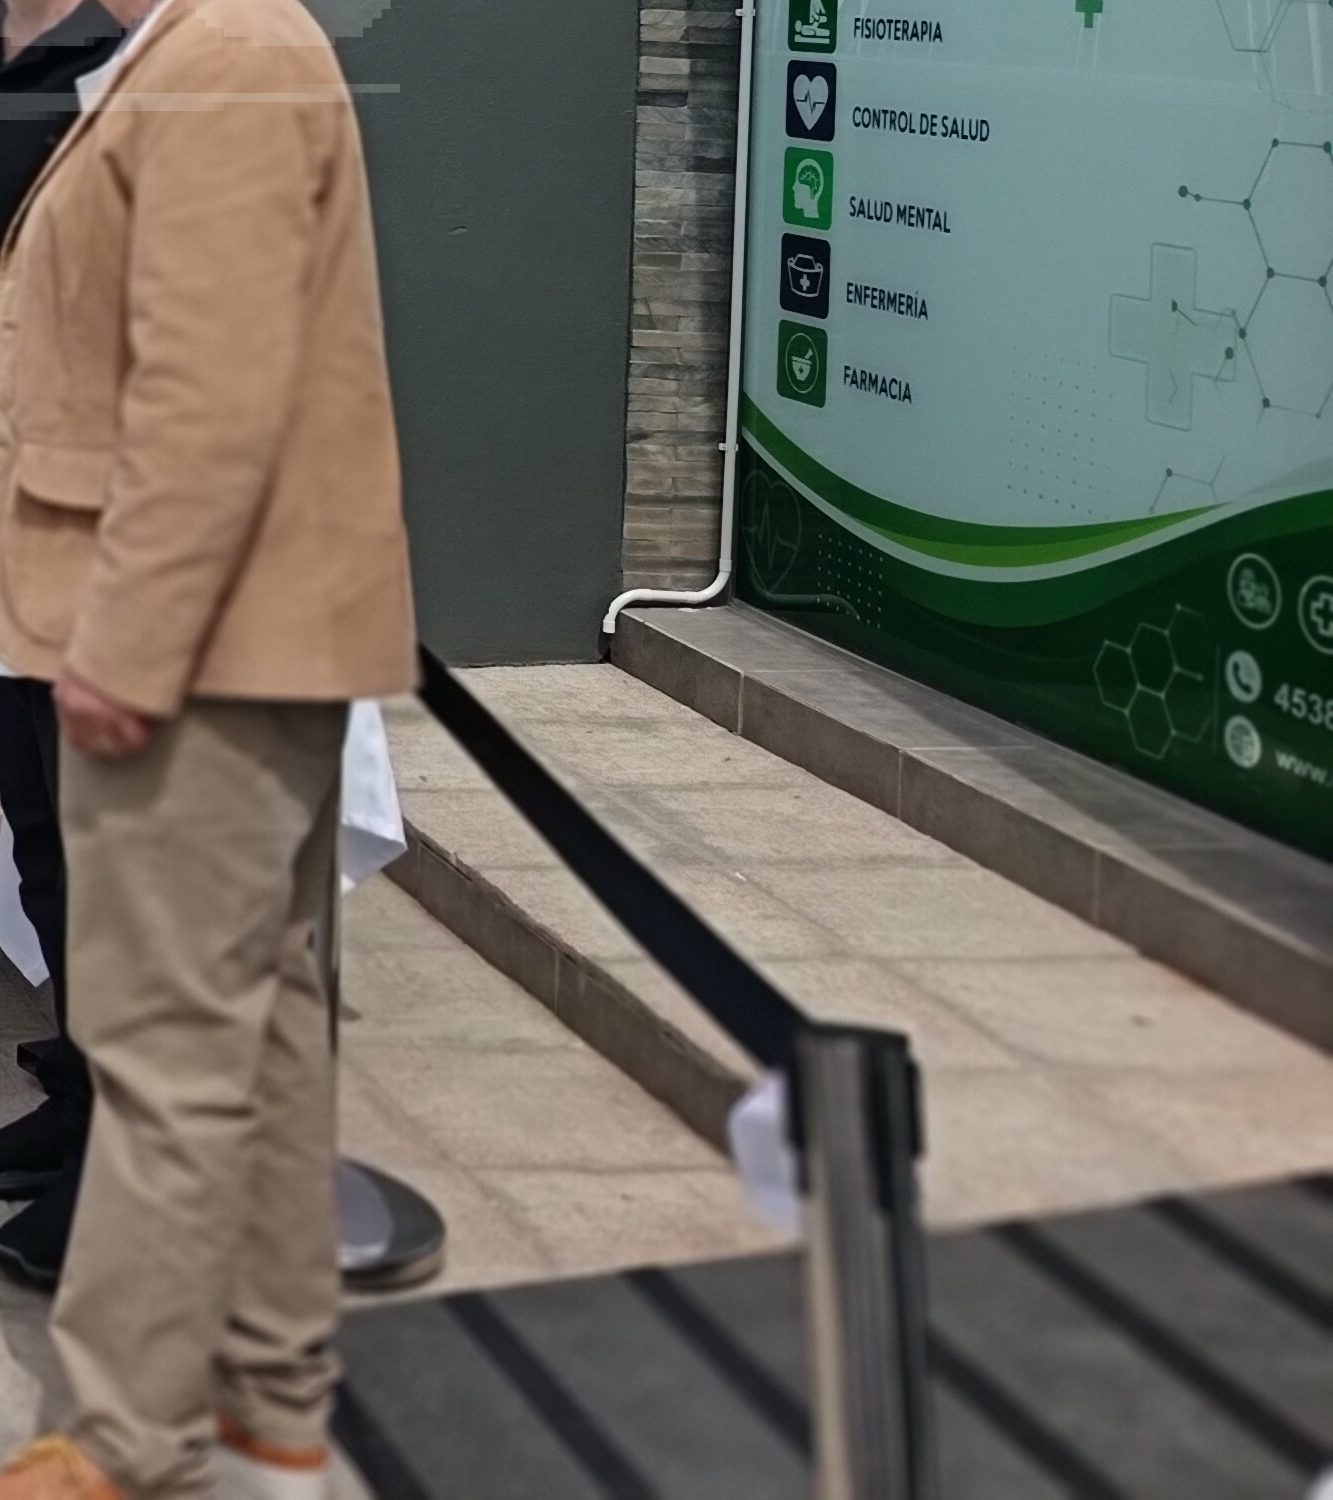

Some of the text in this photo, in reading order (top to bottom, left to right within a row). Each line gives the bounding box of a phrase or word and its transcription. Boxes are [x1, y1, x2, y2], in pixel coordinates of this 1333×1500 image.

[853, 17, 943, 43] FISIOTERAPIA
[852, 106, 990, 143] CONTROL DE SALUD
[849, 196, 951, 234] SALUD MENTAL
[846, 281, 929, 321] ENFERMERÍA
[843, 365, 913, 404] FARMACIA
